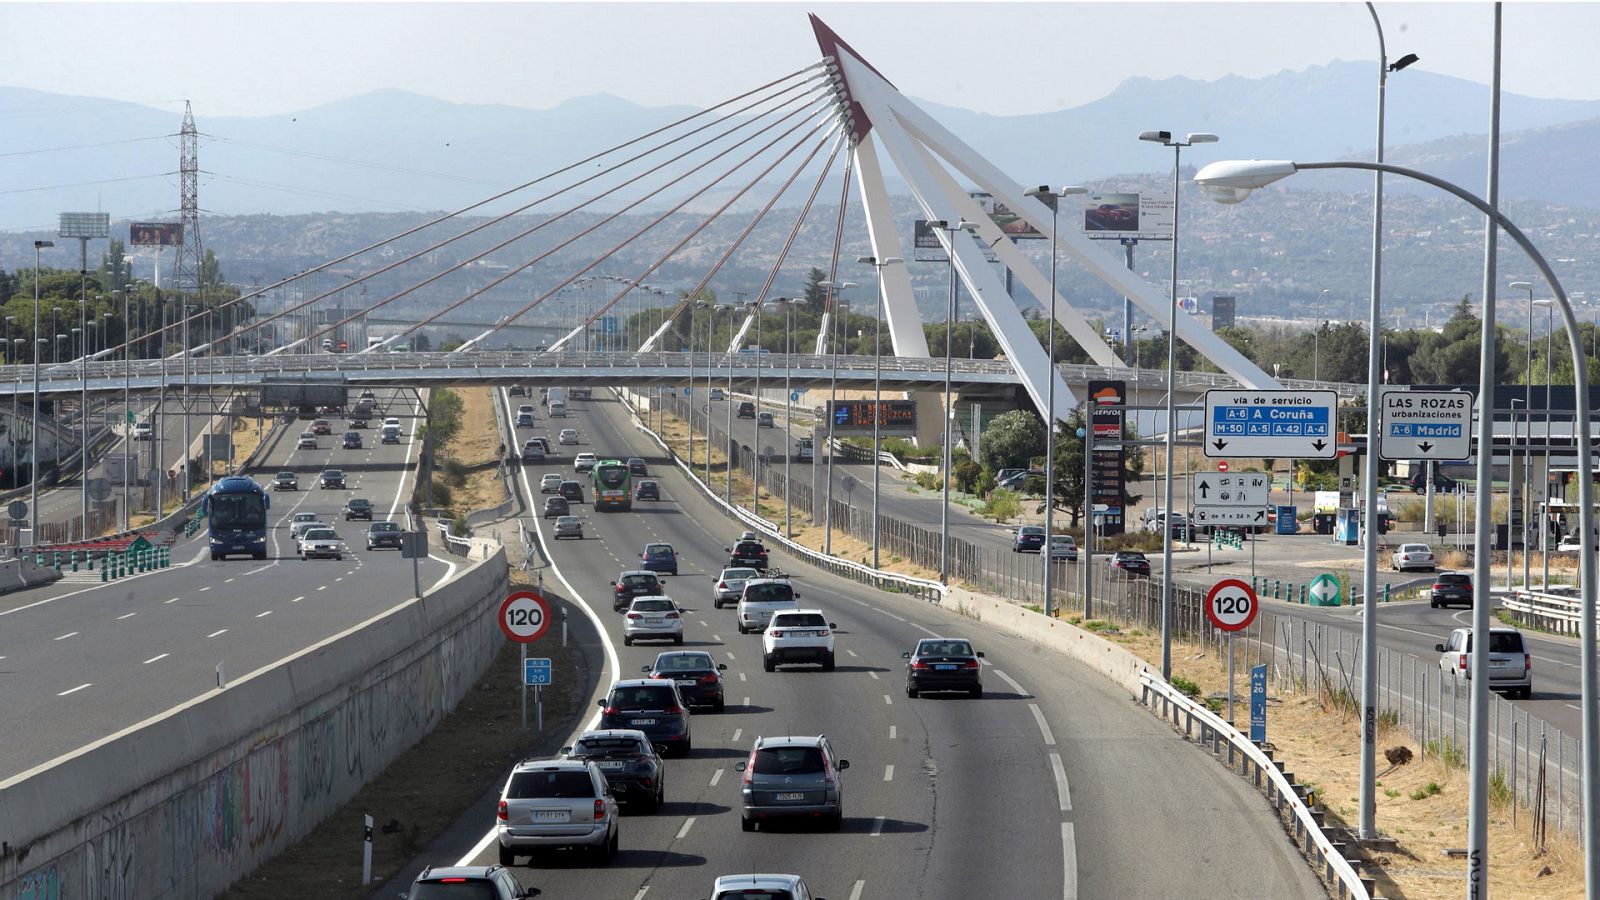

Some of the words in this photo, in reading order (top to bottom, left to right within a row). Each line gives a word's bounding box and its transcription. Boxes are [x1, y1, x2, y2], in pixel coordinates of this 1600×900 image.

[1389, 399, 1413, 408] LAS
[1421, 399, 1464, 408] ROZAS
[1228, 409, 1246, 418] A-6
[1253, 409, 1262, 418] A
[1270, 409, 1314, 419] Coruña
[1216, 424, 1243, 433] M-50
[1250, 424, 1268, 433] A-5
[1275, 425, 1299, 433] A-42
[1307, 425, 1325, 433] A-4
[1393, 426, 1411, 434] A-6
[1417, 426, 1459, 436] Madrid
[1215, 597, 1250, 614] 120
[508, 609, 542, 625] 120
[532, 675, 545, 683] 20
